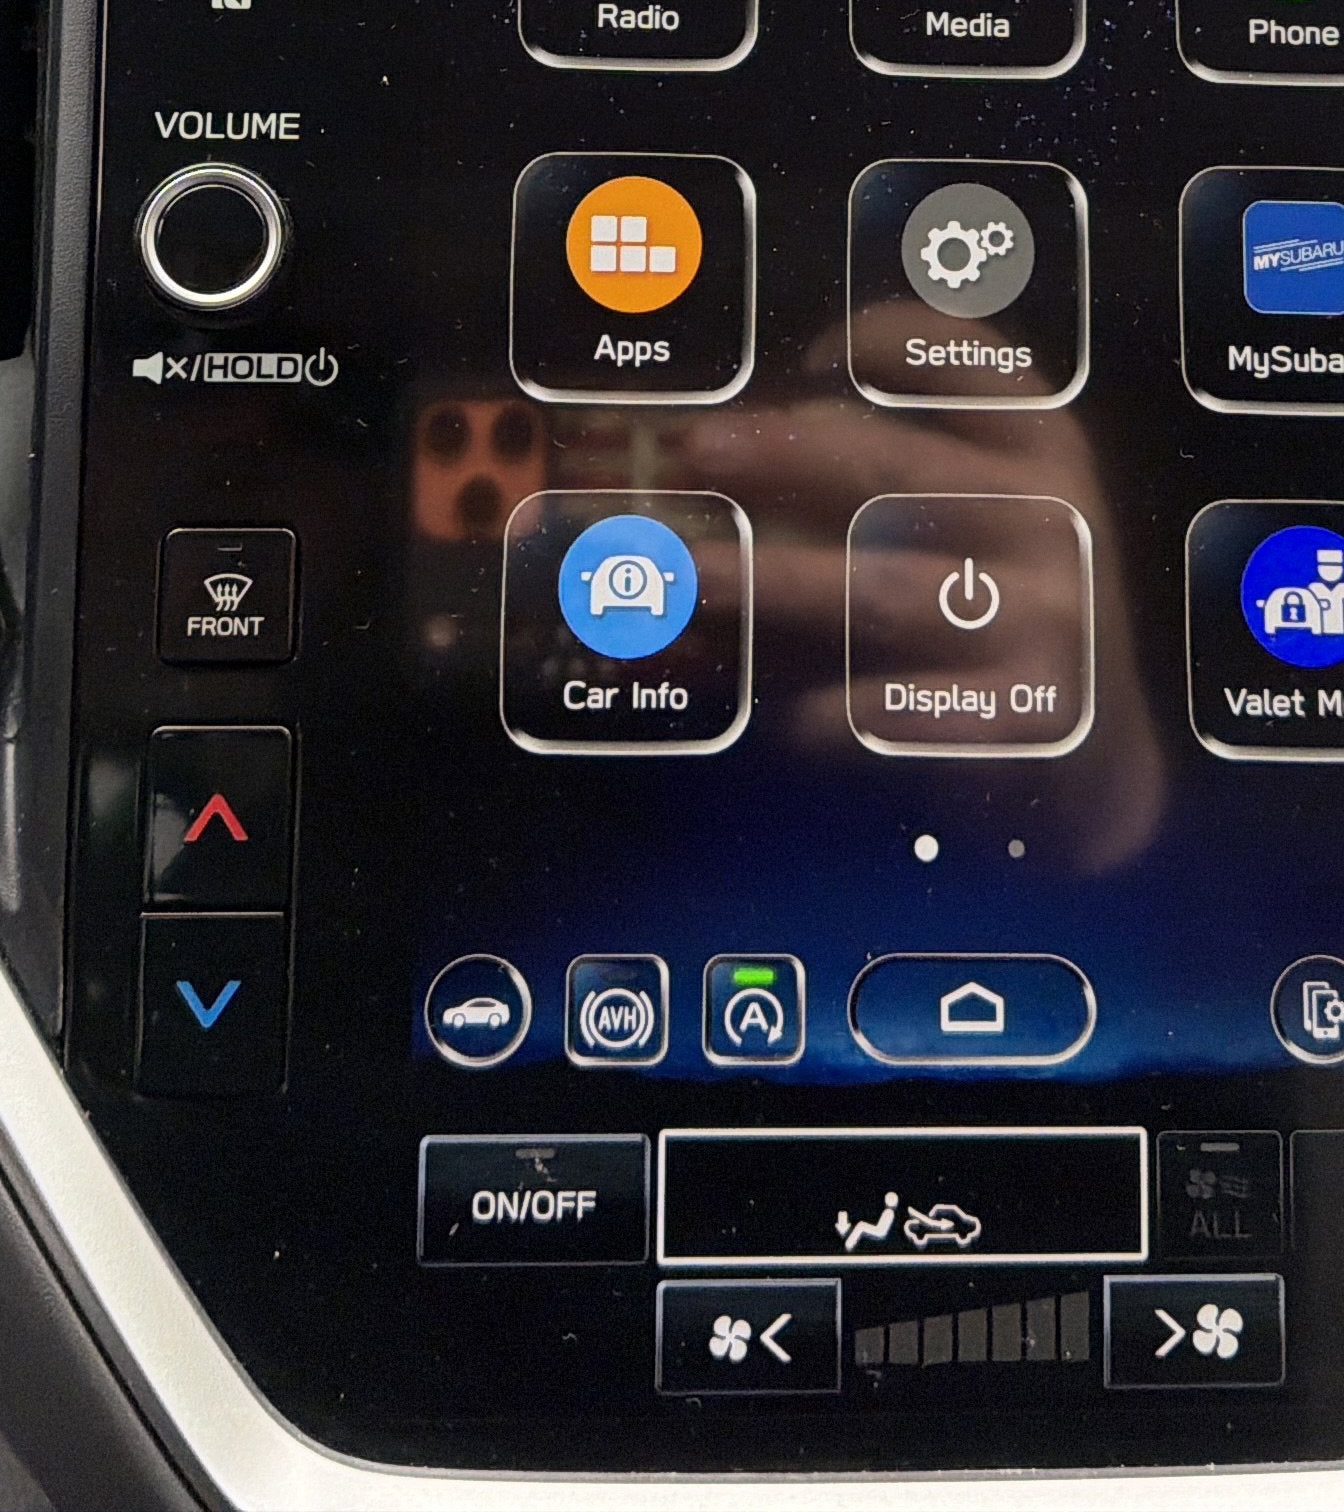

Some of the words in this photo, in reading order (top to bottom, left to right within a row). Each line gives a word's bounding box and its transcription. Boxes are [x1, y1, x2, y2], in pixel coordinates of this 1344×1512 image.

[597, 3, 680, 31] Radio
[926, 11, 1010, 38] Media
[1248, 18, 1340, 46] Phone
[154, 110, 301, 140] VOLUME
[593, 334, 671, 368] Apps
[905, 338, 1032, 374] Settings
[187, 616, 265, 636] FRONT
[563, 680, 620, 710] Car
[632, 681, 689, 710] Info
[885, 683, 996, 720] Display
[1010, 683, 1057, 713] Off
[1224, 687, 1306, 717] Valet
[598, 1005, 637, 1032] AVH
[472, 1190, 597, 1221] ON/OFF
[1191, 1211, 1253, 1238] ALL
